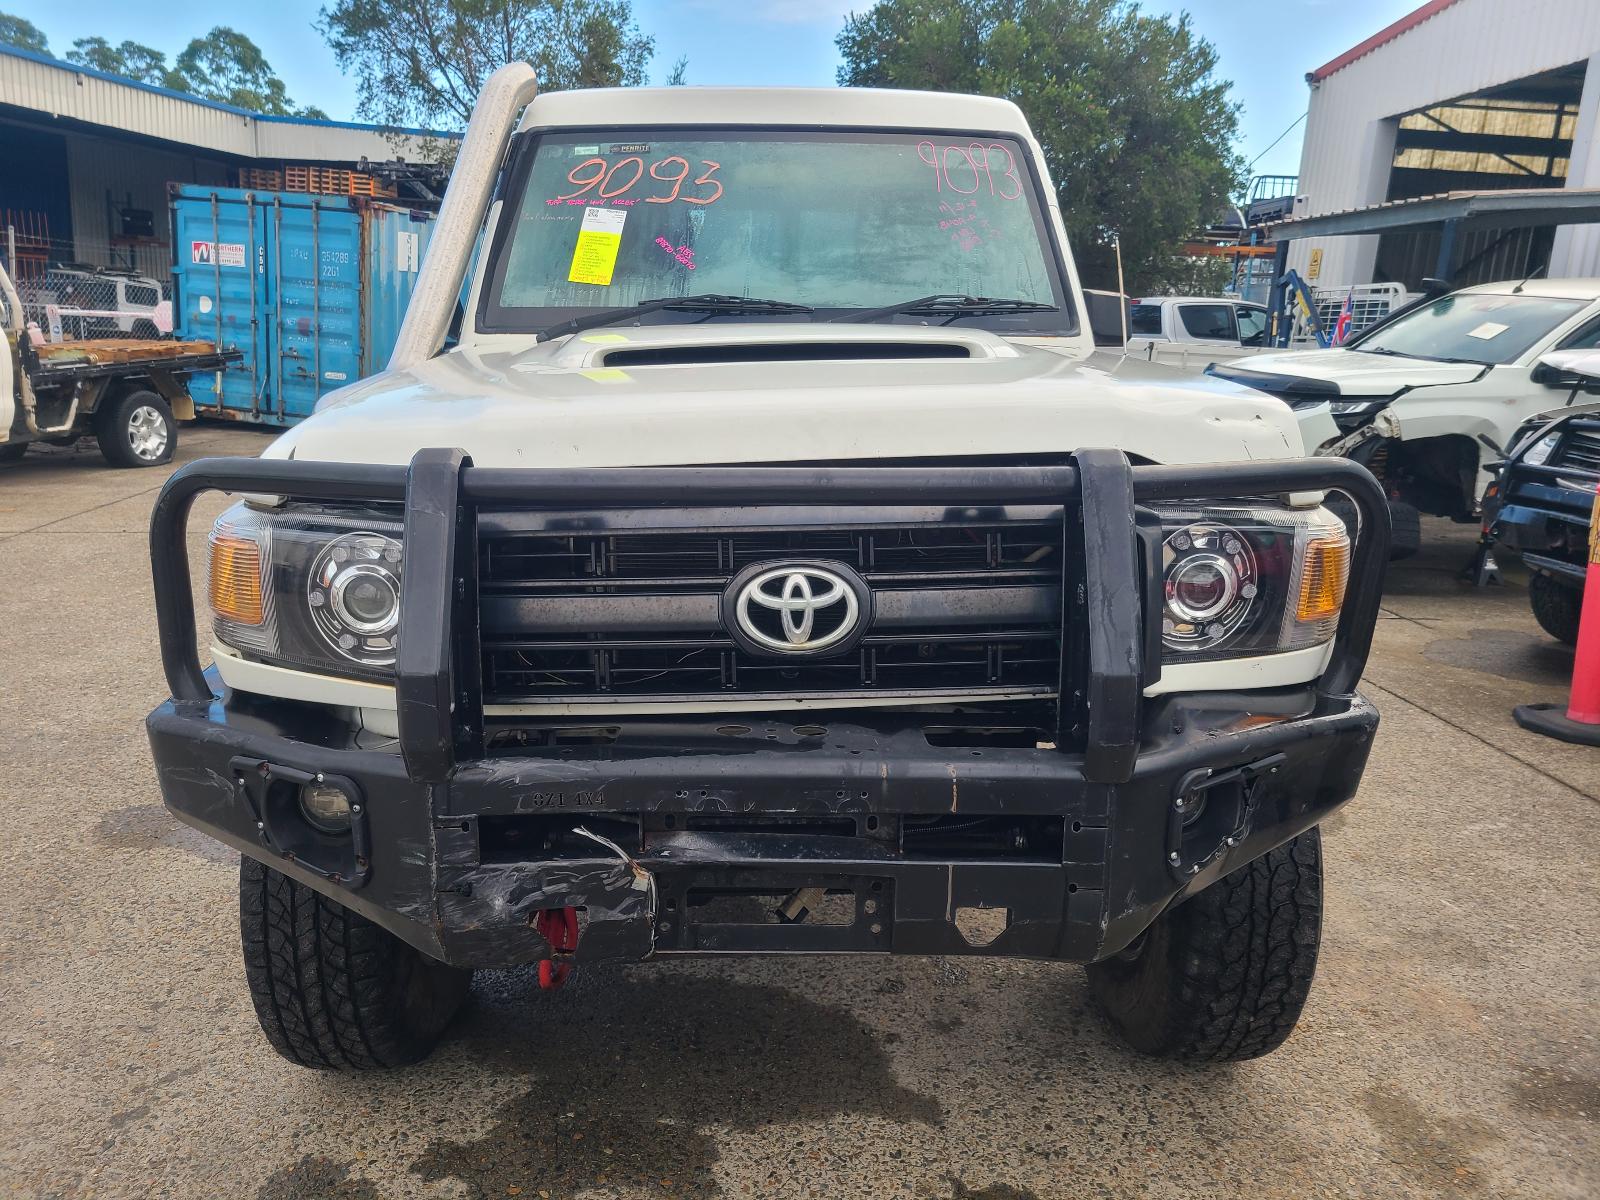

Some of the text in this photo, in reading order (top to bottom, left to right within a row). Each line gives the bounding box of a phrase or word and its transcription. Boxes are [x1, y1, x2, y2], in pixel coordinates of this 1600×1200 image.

[917, 141, 1021, 200] 9093
[557, 156, 724, 205] 9093
[210, 244, 244, 253] NRTHERN
[321, 251, 349, 264] 354289
[323, 265, 340, 277] 22G1
[533, 791, 607, 808] OZI 4X4
